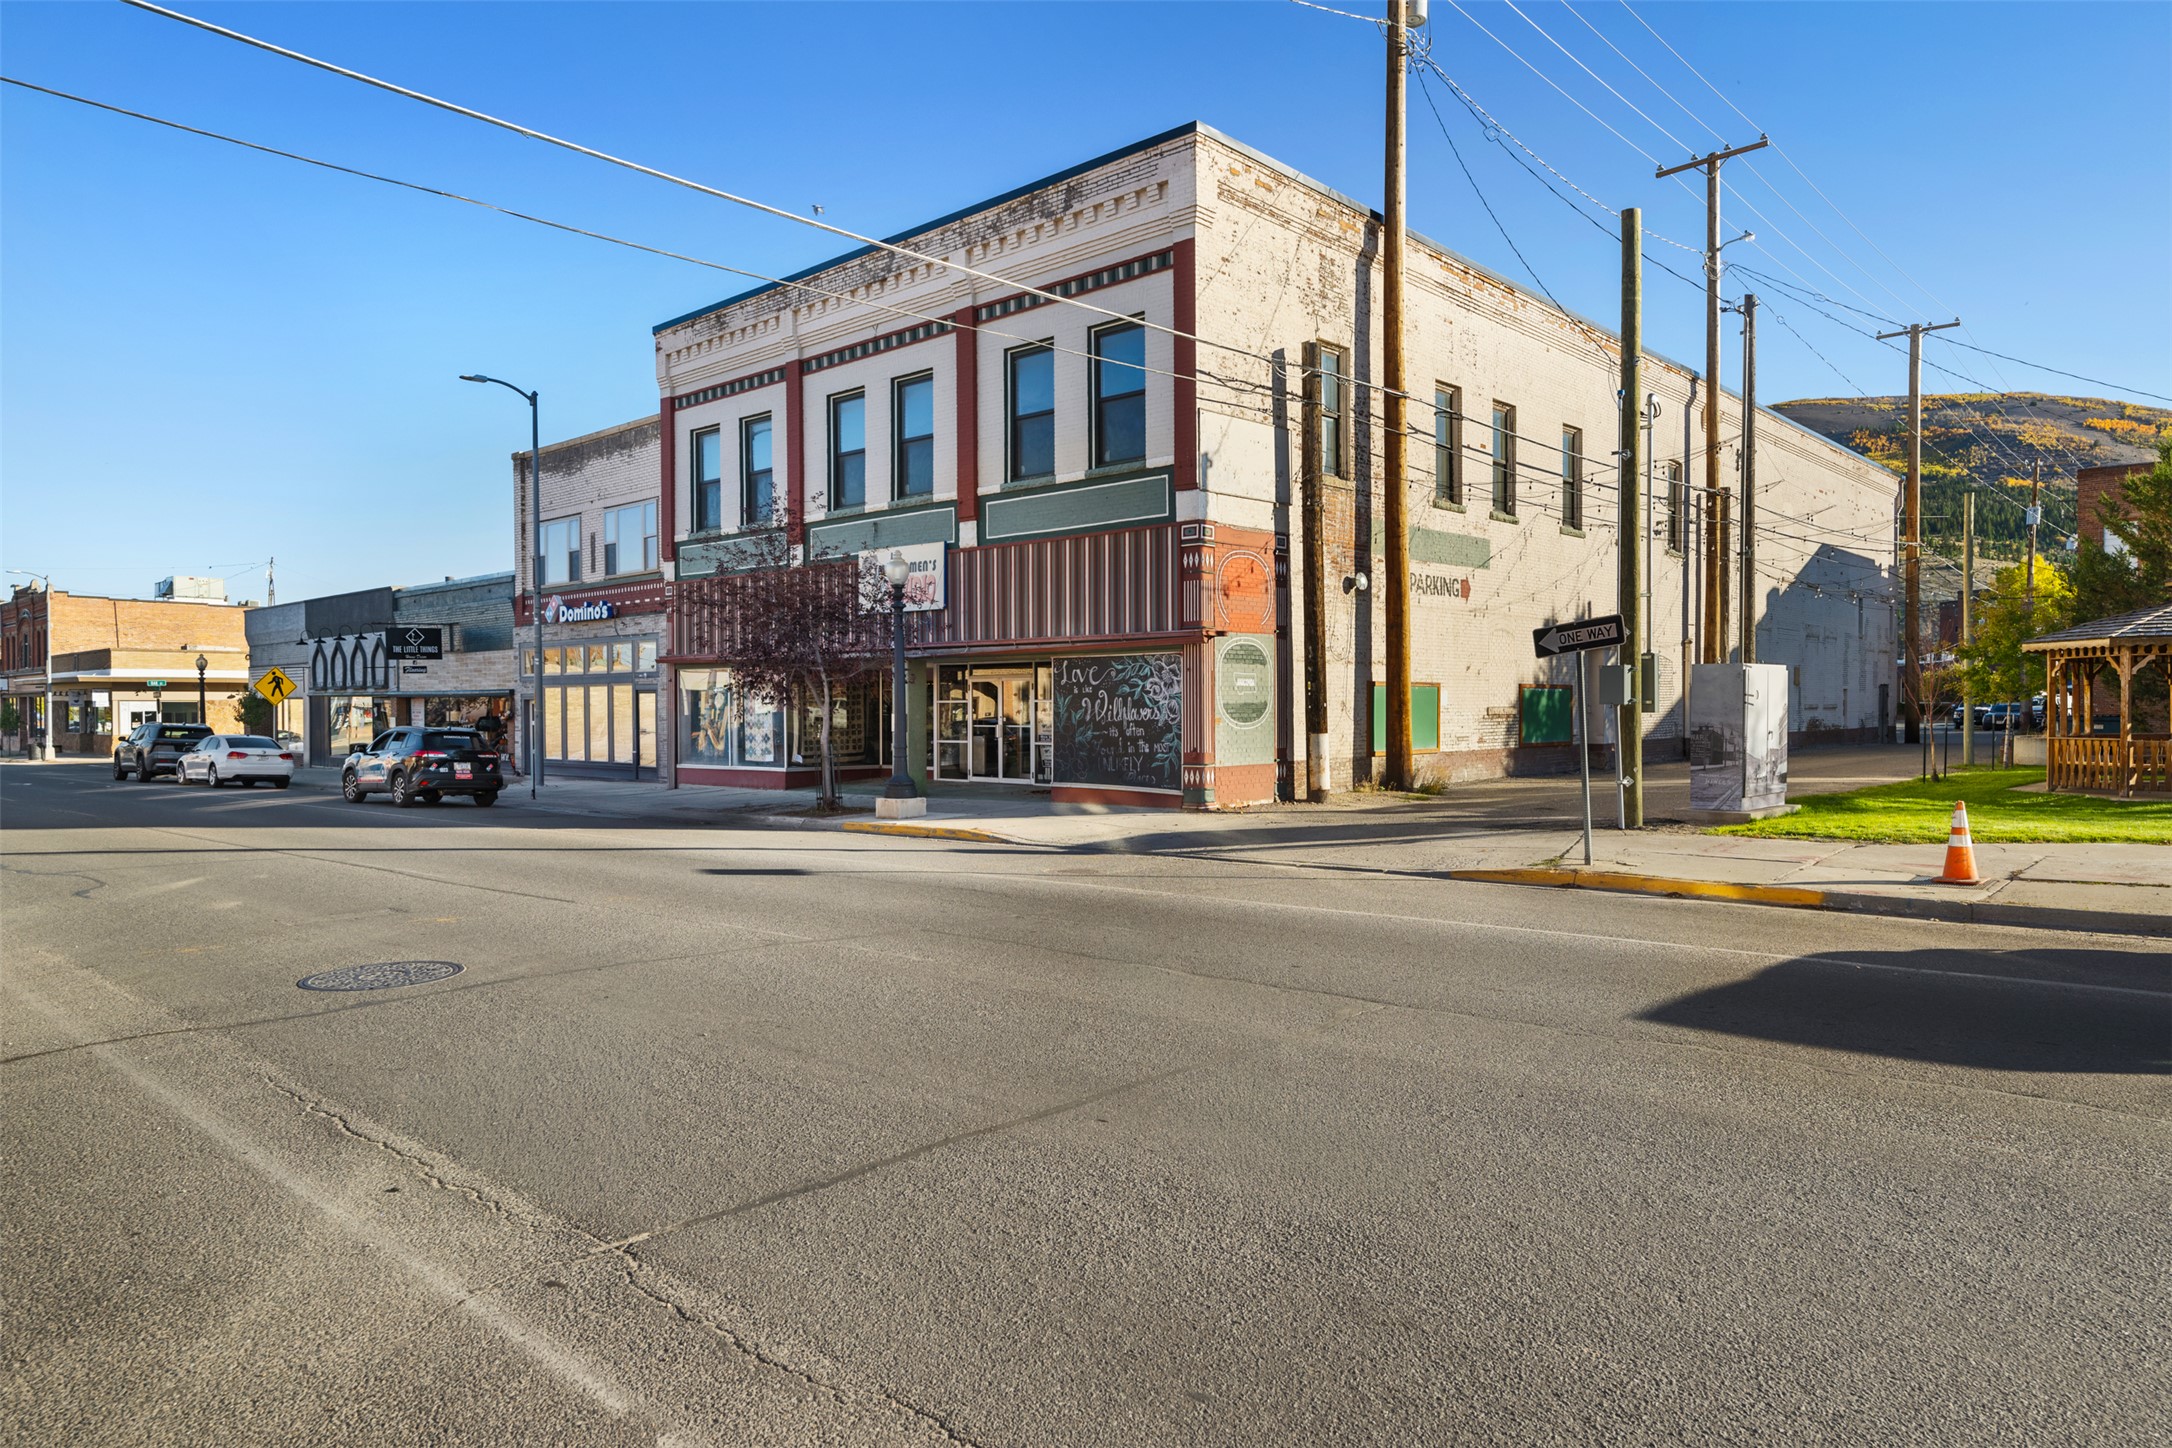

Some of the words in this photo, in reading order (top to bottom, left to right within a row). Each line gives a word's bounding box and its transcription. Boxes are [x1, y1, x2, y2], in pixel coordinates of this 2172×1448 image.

[1409, 572, 1460, 598] PARKING
[559, 600, 609, 623] Domino's
[1558, 630, 1584, 645] ONE
[1586, 625, 1613, 640] WAY
[392, 645, 402, 653] THE
[403, 645, 419, 653] LITTLE
[420, 645, 439, 653] THINGS
[1056, 660, 1114, 686] Love
[1125, 723, 1145, 737] often
[1127, 741, 1135, 753] in
[1137, 739, 1150, 753] the
